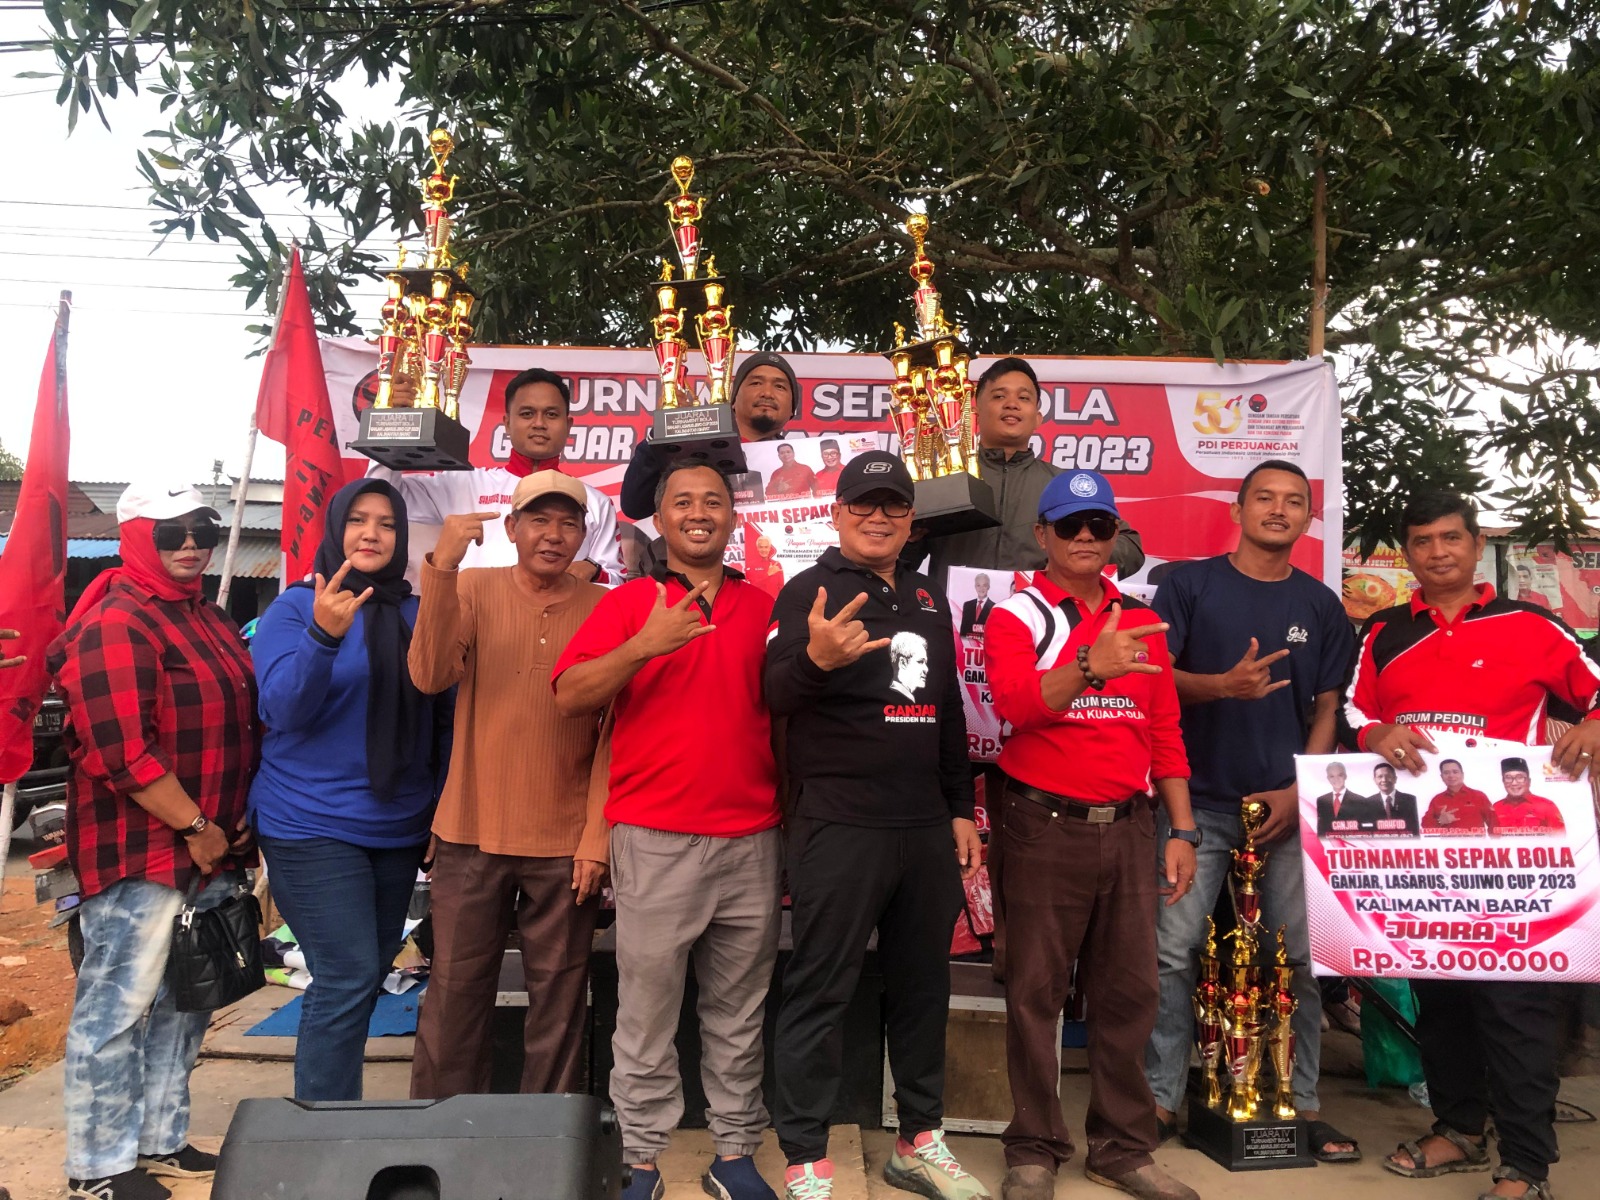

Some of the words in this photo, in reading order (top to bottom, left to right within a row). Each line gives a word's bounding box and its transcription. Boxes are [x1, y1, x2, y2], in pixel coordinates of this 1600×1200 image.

[1052, 435, 1152, 471] 2023
[1198, 440, 1218, 449] PDI
[1221, 441, 1298, 450] PERJUANGAN
[782, 504, 831, 524] SEPAK
[883, 704, 936, 717] GANJAR
[1072, 696, 1100, 708] RUM
[1395, 712, 1430, 724] FORUM
[1434, 713, 1484, 728] PEDULI
[1326, 848, 1439, 870] TURNAMEN
[1446, 848, 1514, 869] SEPAK
[1518, 847, 1575, 868] BOLA
[1331, 875, 1383, 891] GANJAR,
[1387, 875, 1448, 891] LASARUS,
[1451, 874, 1503, 890] SUJIWO
[1508, 874, 1536, 890] CUP
[1539, 874, 1576, 889] 2023
[1356, 898, 1480, 913] KALIMANTAN
[1486, 899, 1552, 913] BARAT
[1386, 921, 1494, 940] JUARA
[1507, 922, 1529, 941] 4
[1354, 949, 1401, 973] Rp.
[1411, 950, 1568, 972] 3.000.000
